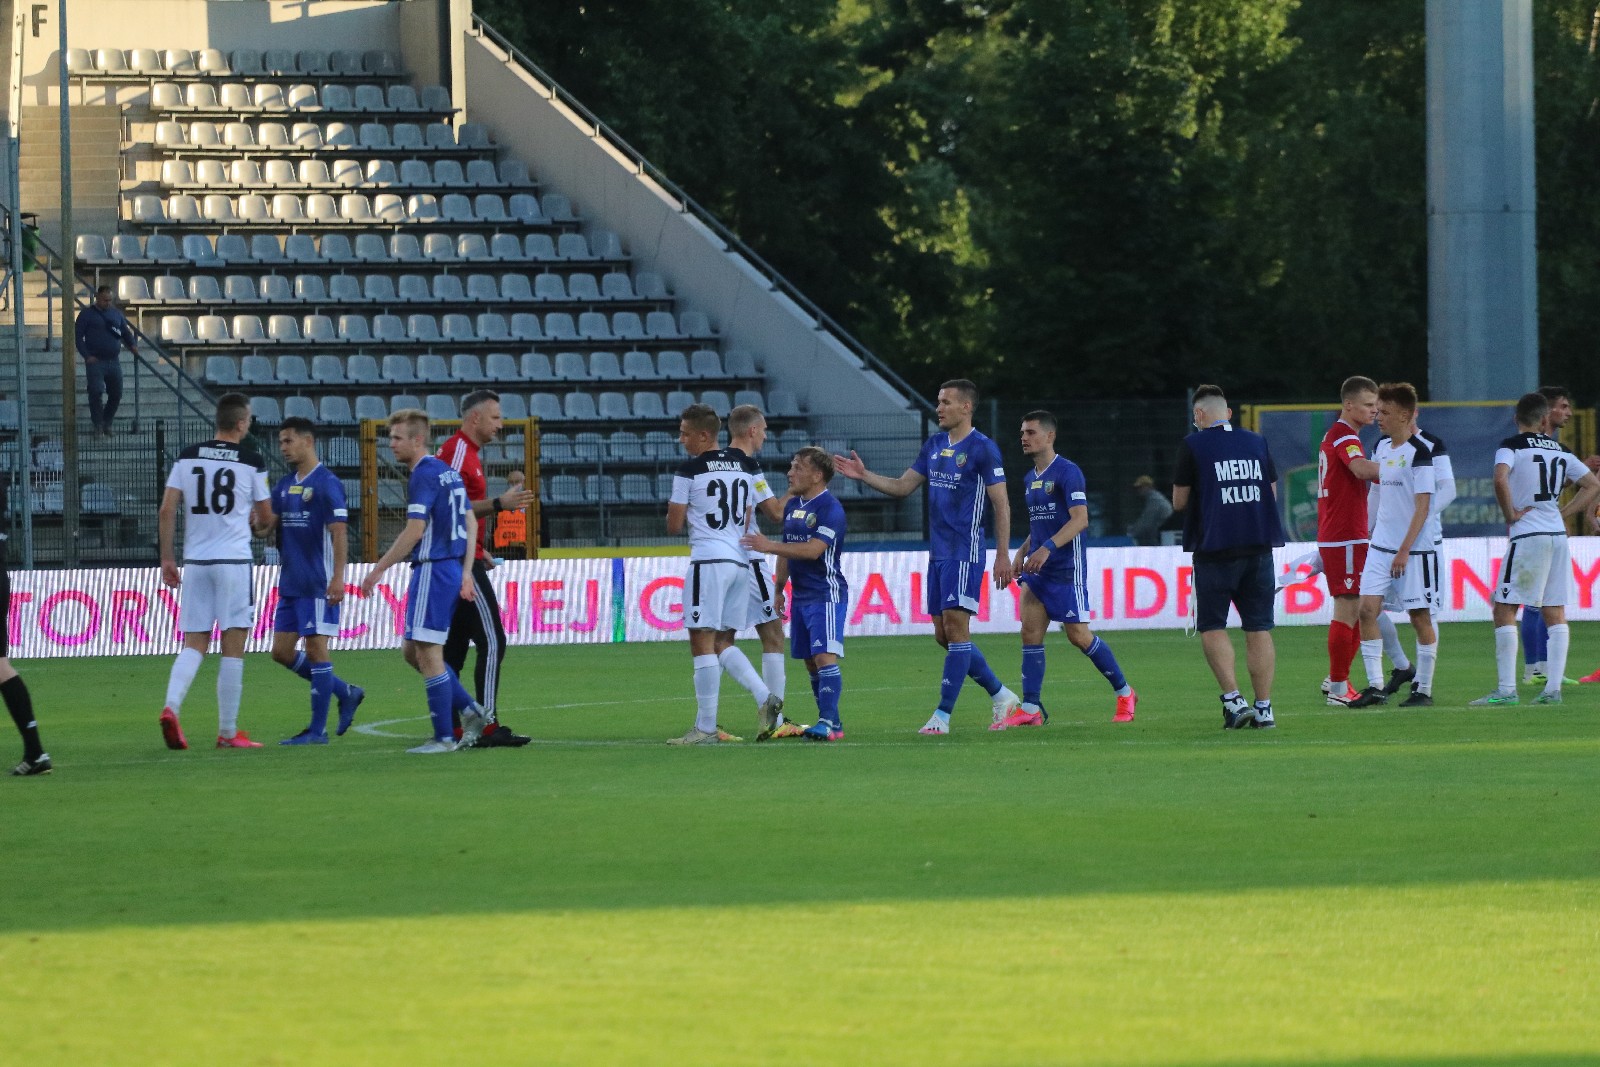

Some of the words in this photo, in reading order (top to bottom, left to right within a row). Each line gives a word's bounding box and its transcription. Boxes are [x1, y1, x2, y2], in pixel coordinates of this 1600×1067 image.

[32, 4, 48, 38] F
[191, 466, 236, 515] 18
[1214, 459, 1263, 481] MEDIA
[1533, 454, 1567, 502] 10
[706, 478, 749, 530] 30
[1221, 485, 1261, 504] KLUB
